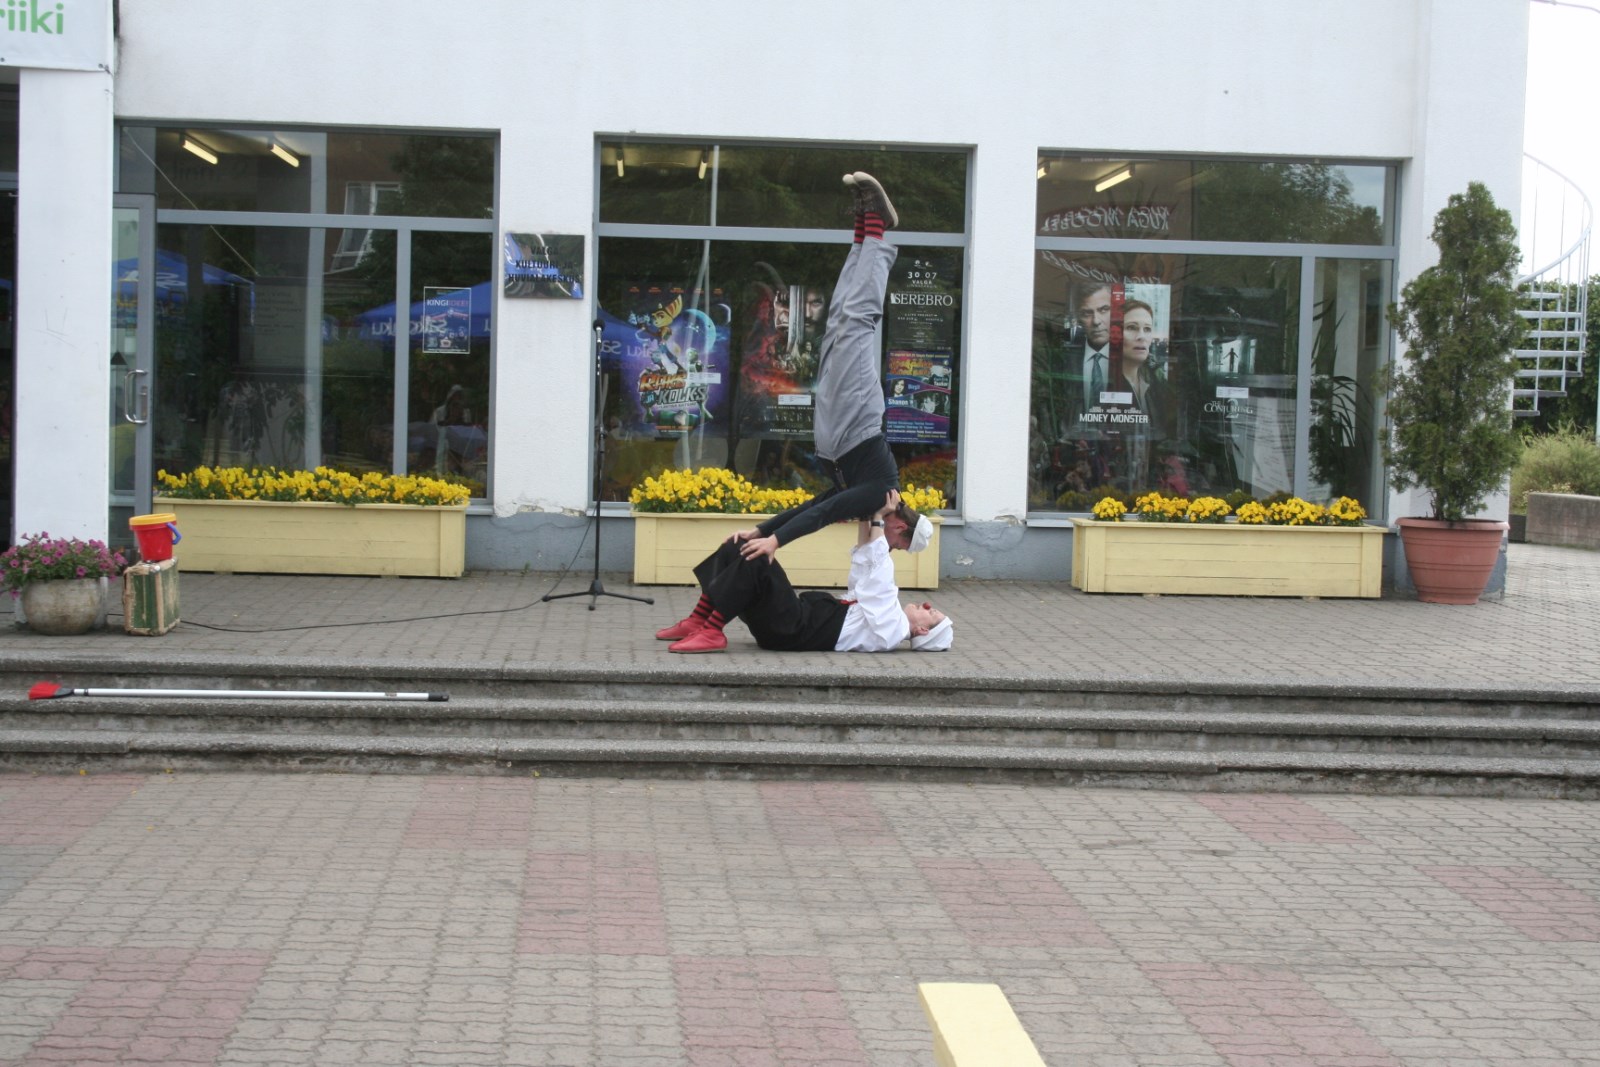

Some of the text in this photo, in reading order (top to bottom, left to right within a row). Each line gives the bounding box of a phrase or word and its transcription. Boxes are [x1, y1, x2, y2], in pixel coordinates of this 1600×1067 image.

[894, 293, 953, 306] SEREBRO
[1080, 413, 1149, 424] MONEY MONSTER
